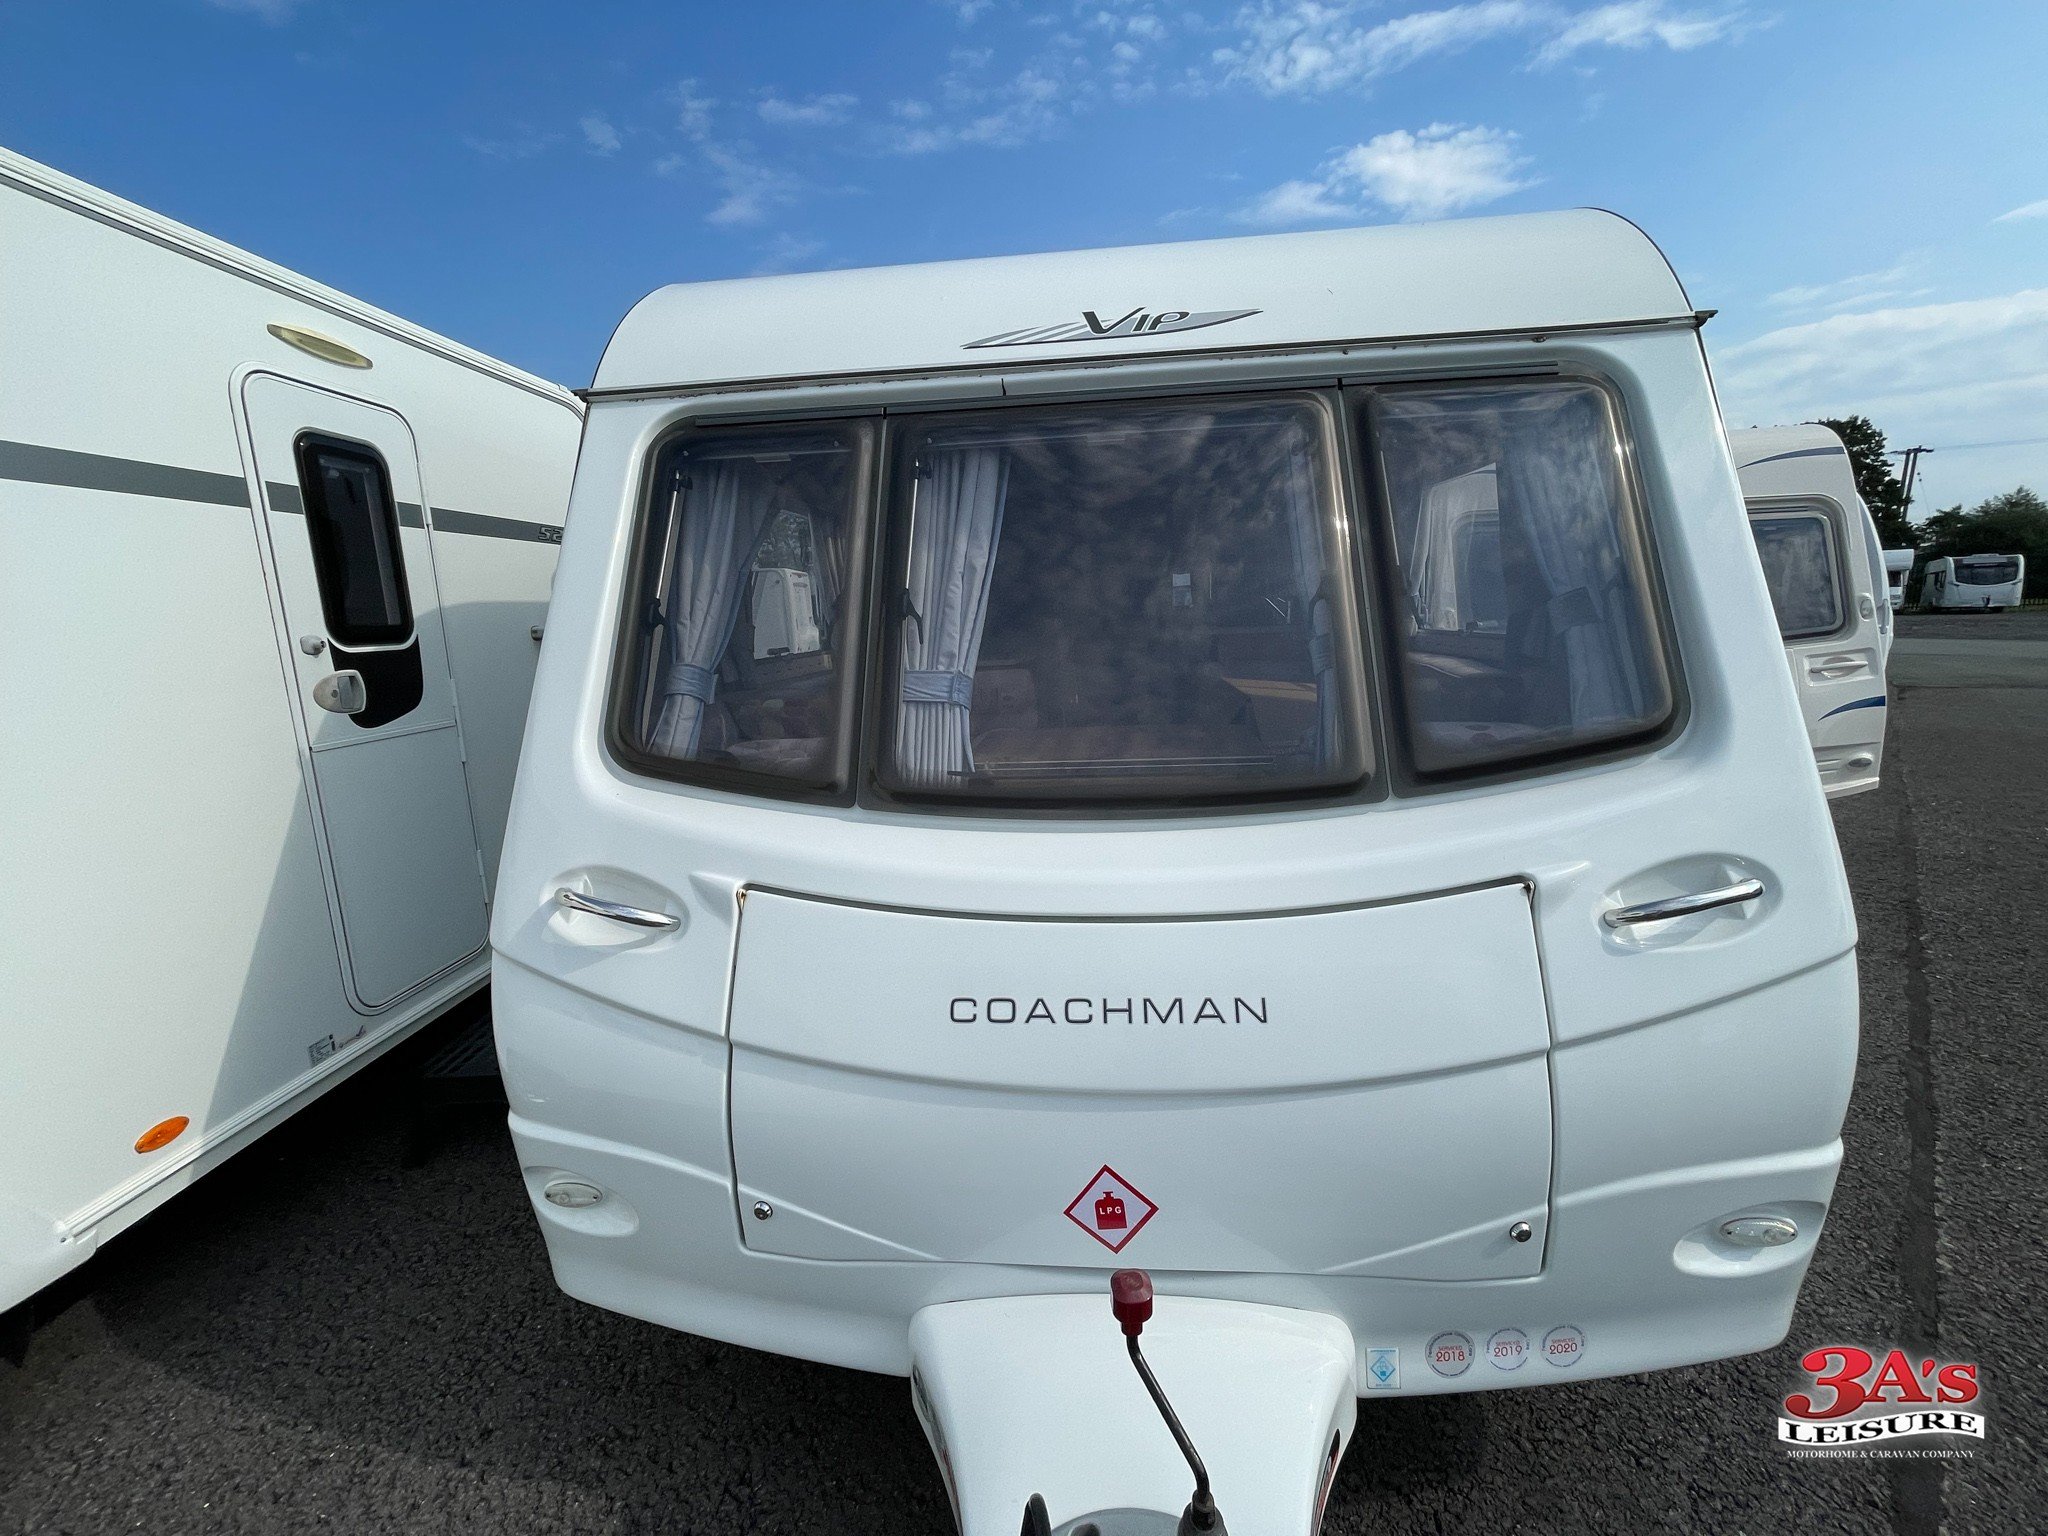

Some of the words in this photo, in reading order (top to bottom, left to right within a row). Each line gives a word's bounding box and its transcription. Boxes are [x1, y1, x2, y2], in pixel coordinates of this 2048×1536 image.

[950, 997, 1268, 1024] COACHMAN
[1099, 1206, 1122, 1215] LPG
[1493, 1345, 1522, 1357] 2019
[1549, 1342, 1577, 1354] 2020
[1436, 1350, 1466, 1362] 2018
